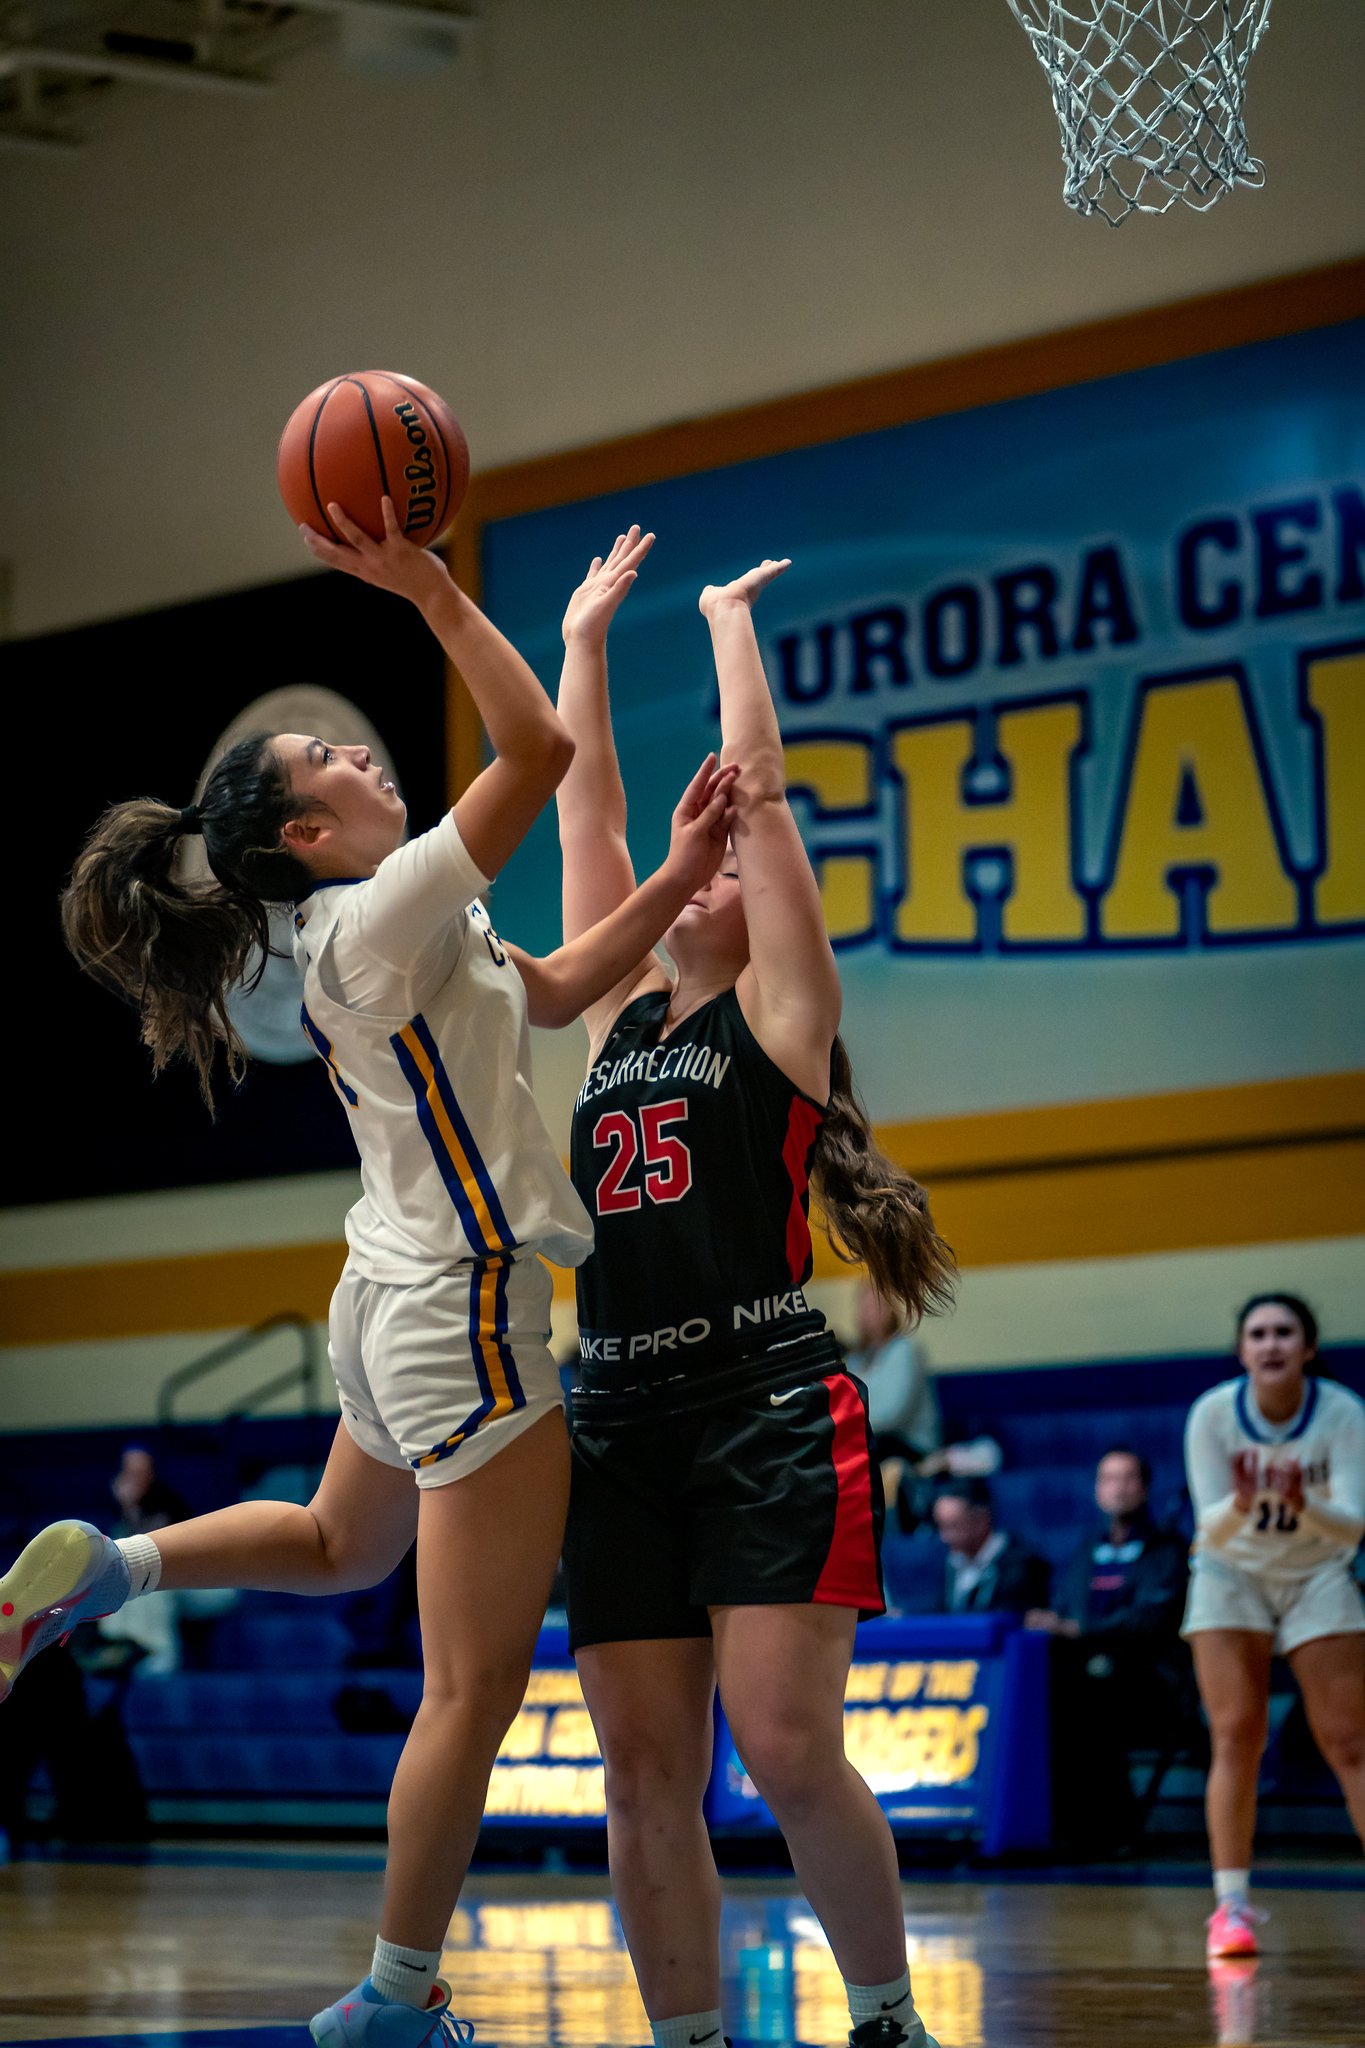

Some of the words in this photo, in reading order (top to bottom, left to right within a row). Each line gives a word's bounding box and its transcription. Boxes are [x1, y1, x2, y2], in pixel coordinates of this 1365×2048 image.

[393, 401, 437, 536] Wilson
[712, 541, 1140, 722] URORA
[783, 638, 1365, 952] HA
[592, 1097, 692, 1216] 25
[579, 1337, 622, 1361] IKE
[628, 1317, 711, 1360] PRO
[733, 1290, 808, 1330] NIKE
